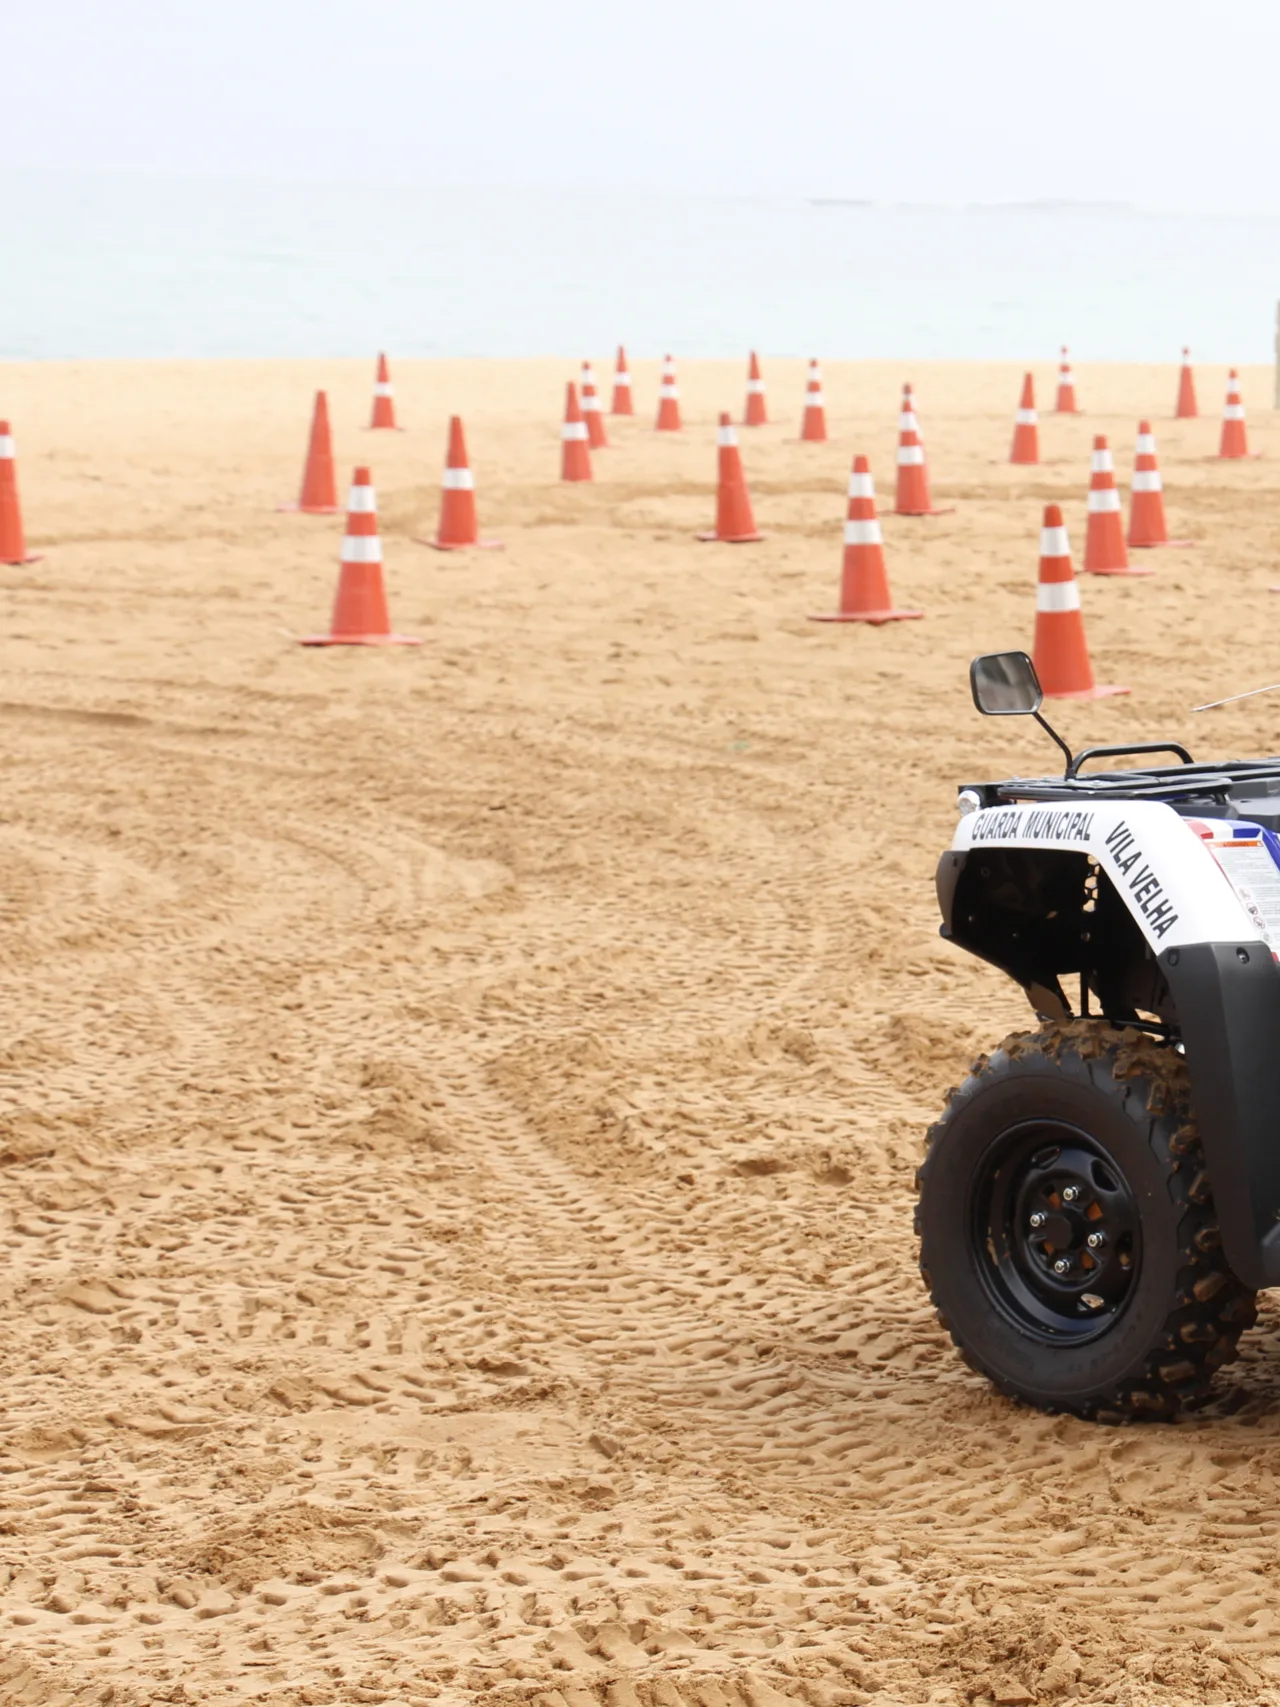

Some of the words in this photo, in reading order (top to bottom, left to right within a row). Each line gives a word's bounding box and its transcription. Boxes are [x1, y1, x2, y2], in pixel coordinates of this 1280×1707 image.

[971, 811, 1023, 841] GUARDA
[1022, 811, 1095, 841] MUNICIPAL
[1105, 820, 1142, 876] VILA
[1129, 864, 1179, 939] VELHA
